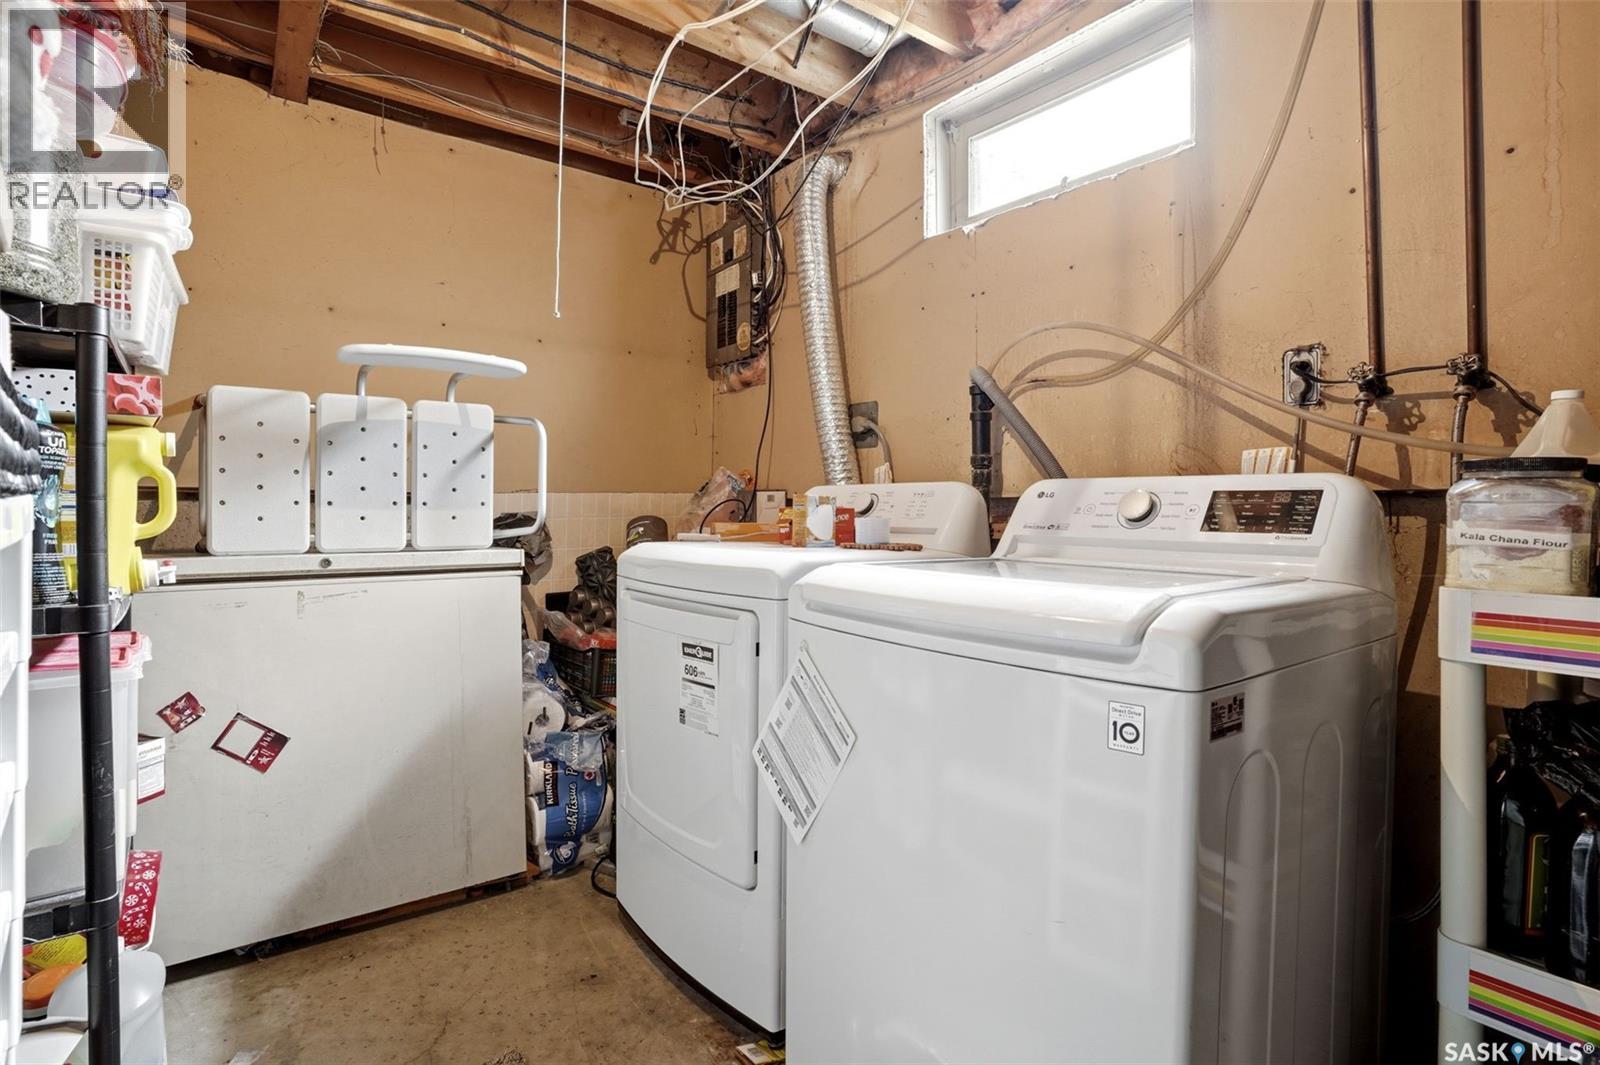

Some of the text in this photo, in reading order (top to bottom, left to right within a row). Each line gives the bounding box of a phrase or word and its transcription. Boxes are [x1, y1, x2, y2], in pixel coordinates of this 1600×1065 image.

[1460, 532, 1569, 548] Kala Chana Flour
[684, 663, 698, 677] 606
[1112, 720, 1140, 744] 10
[545, 762, 554, 805] KIRKLAND
[566, 782, 579, 814] Tissue
